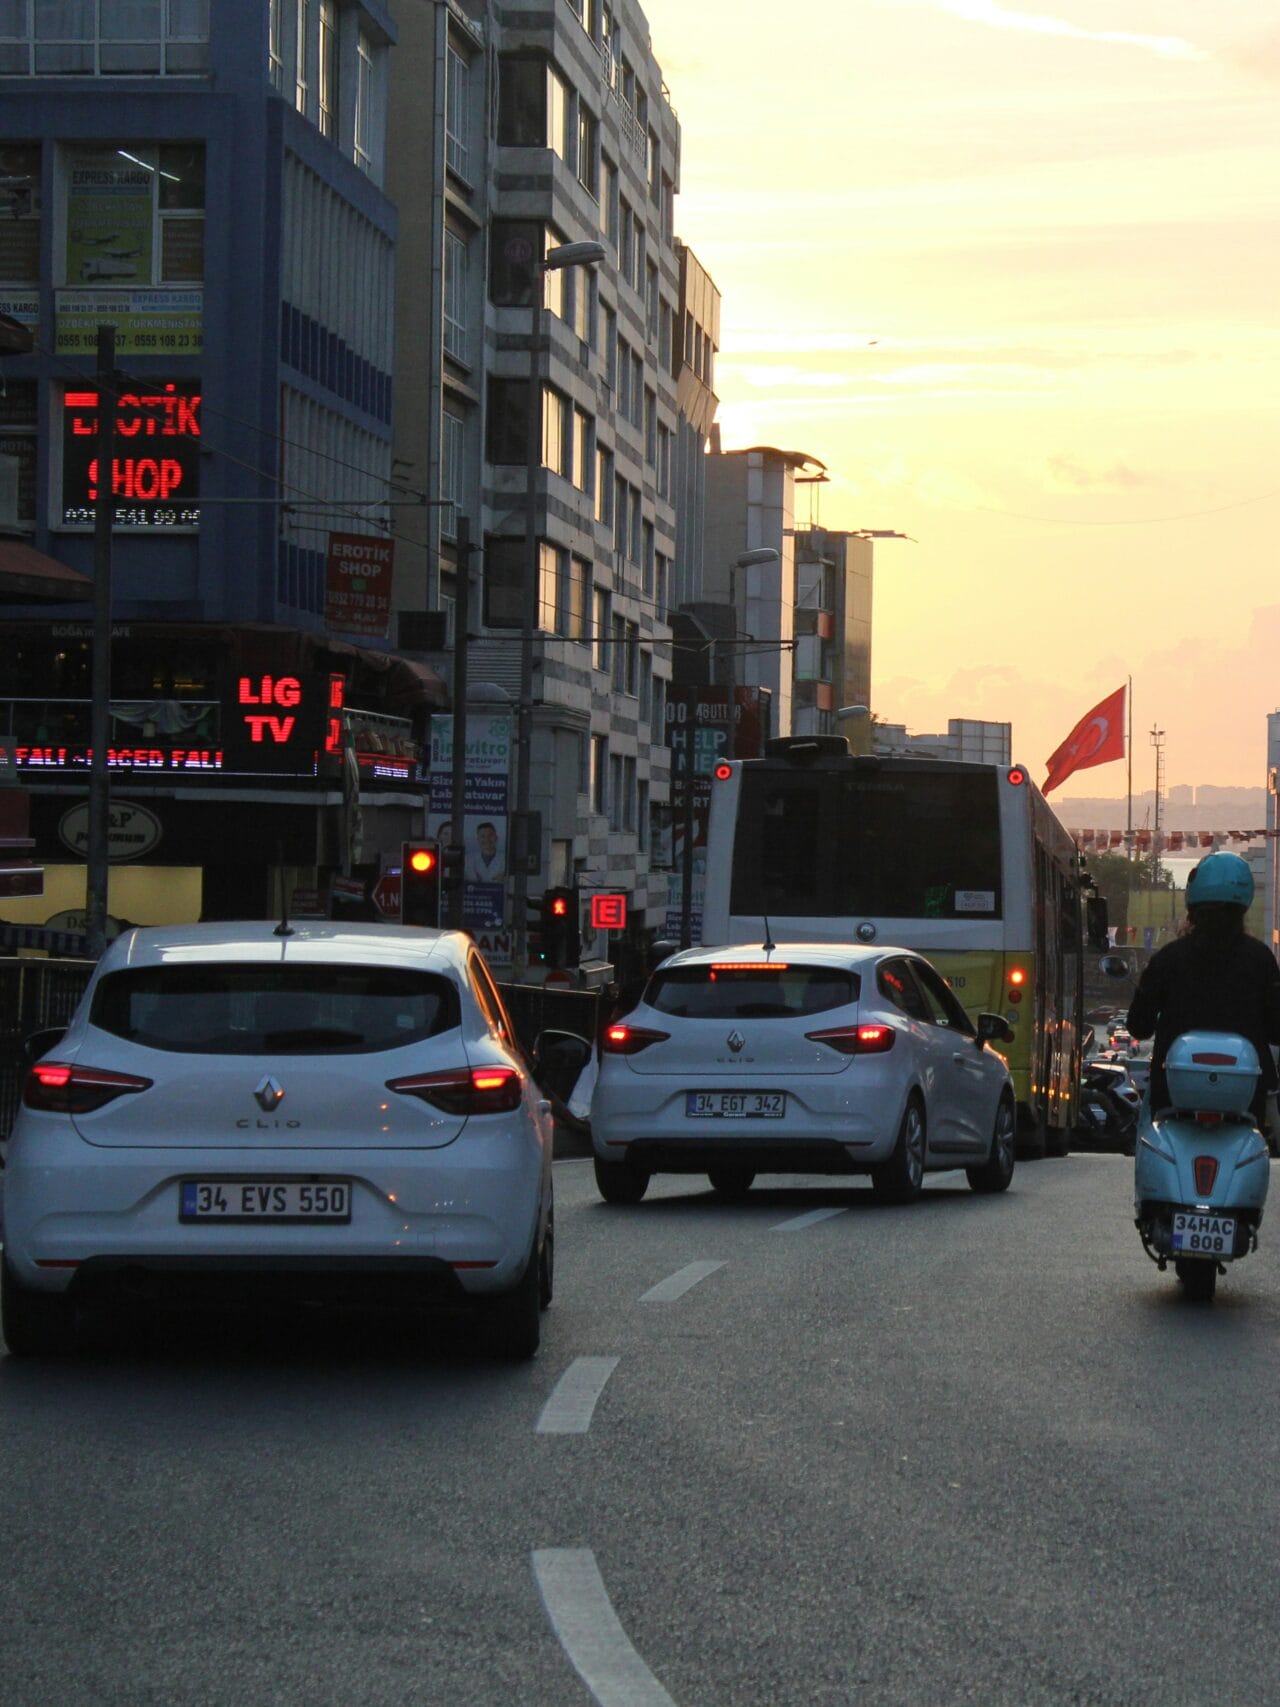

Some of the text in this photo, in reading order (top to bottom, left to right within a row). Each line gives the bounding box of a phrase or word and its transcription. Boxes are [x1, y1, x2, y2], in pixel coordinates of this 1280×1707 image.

[339, 561, 381, 576] SHOP
[244, 715, 296, 743] TV
[474, 776, 506, 787] Yakın
[431, 788, 505, 800] Labatuvar
[697, 1095, 714, 1111] 34
[754, 1096, 780, 1111] 342
[235, 1119, 302, 1130] CLIO
[198, 1186, 345, 1213] 34 EVS 550
[1175, 1215, 1233, 1236] 34HAC
[1189, 1234, 1225, 1250] 808
